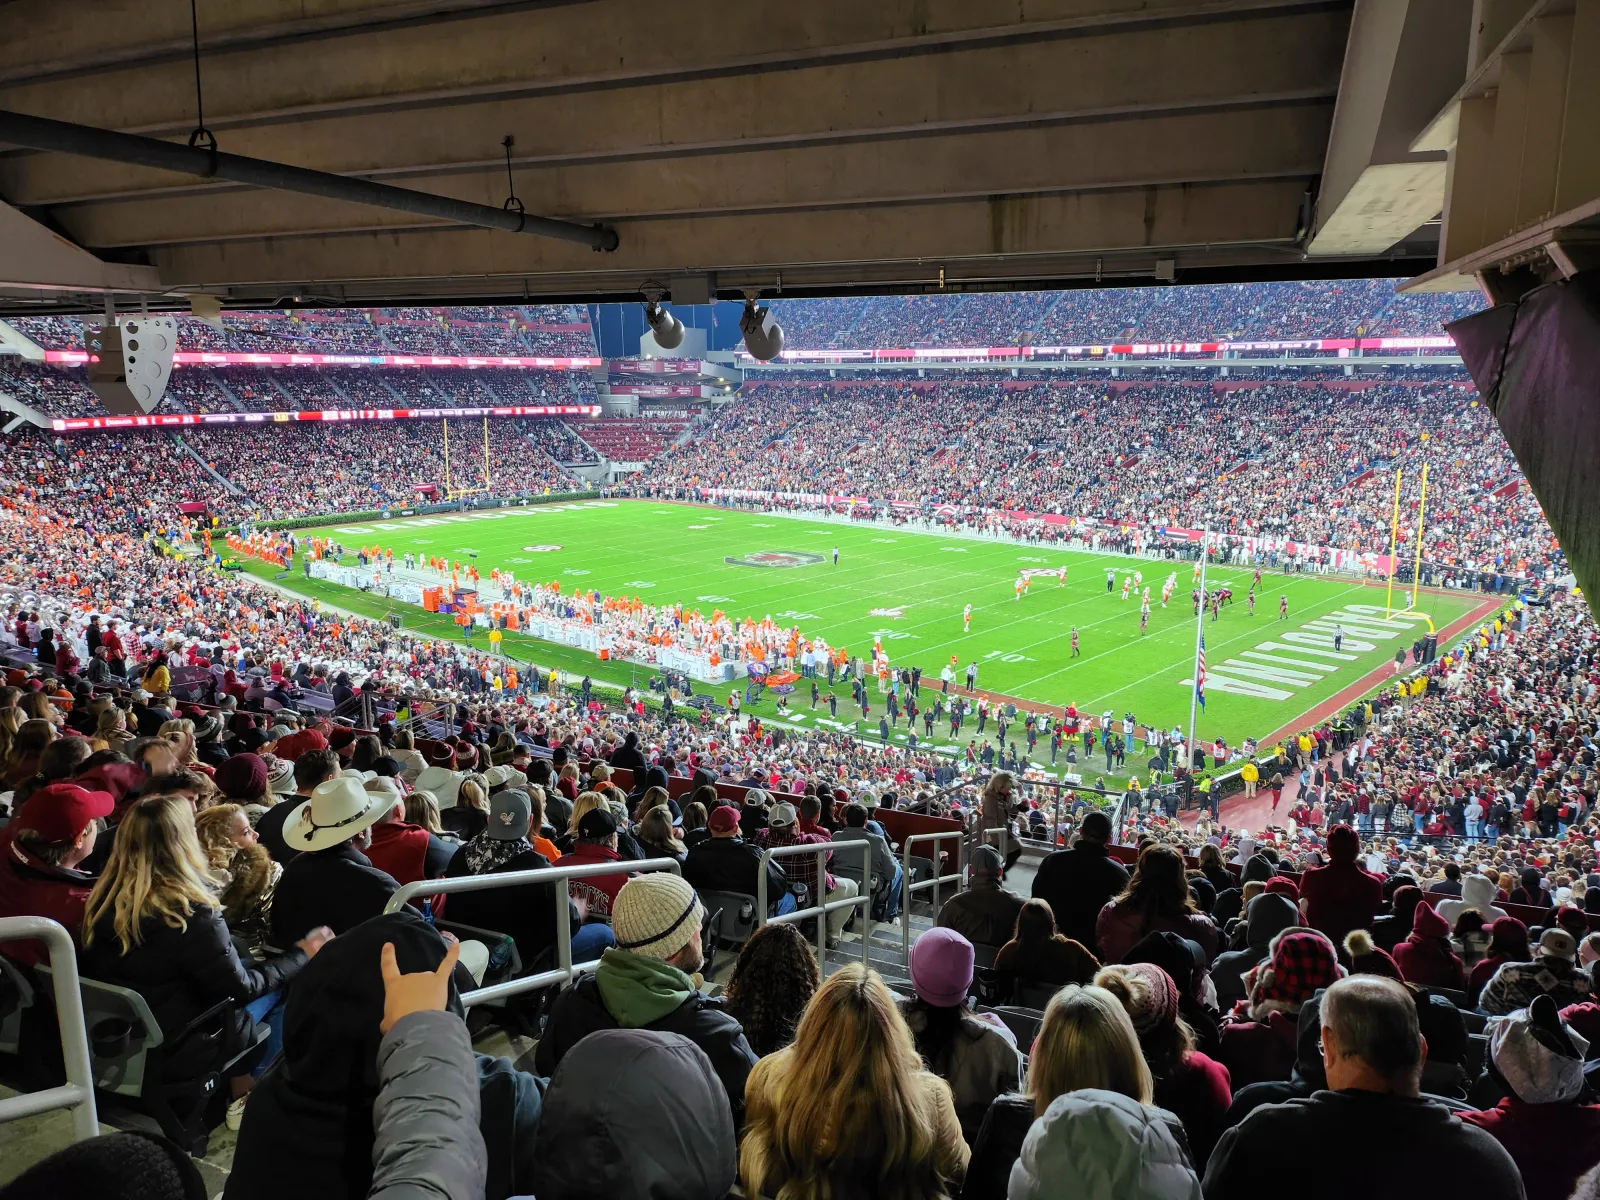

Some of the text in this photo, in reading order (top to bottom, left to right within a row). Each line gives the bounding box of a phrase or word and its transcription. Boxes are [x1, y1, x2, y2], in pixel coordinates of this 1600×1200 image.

[334, 502, 620, 534] GAMECOCKS
[983, 650, 1026, 663] 10
[1178, 604, 1431, 701] CAROLINA
[204, 1079, 215, 1093] 11
